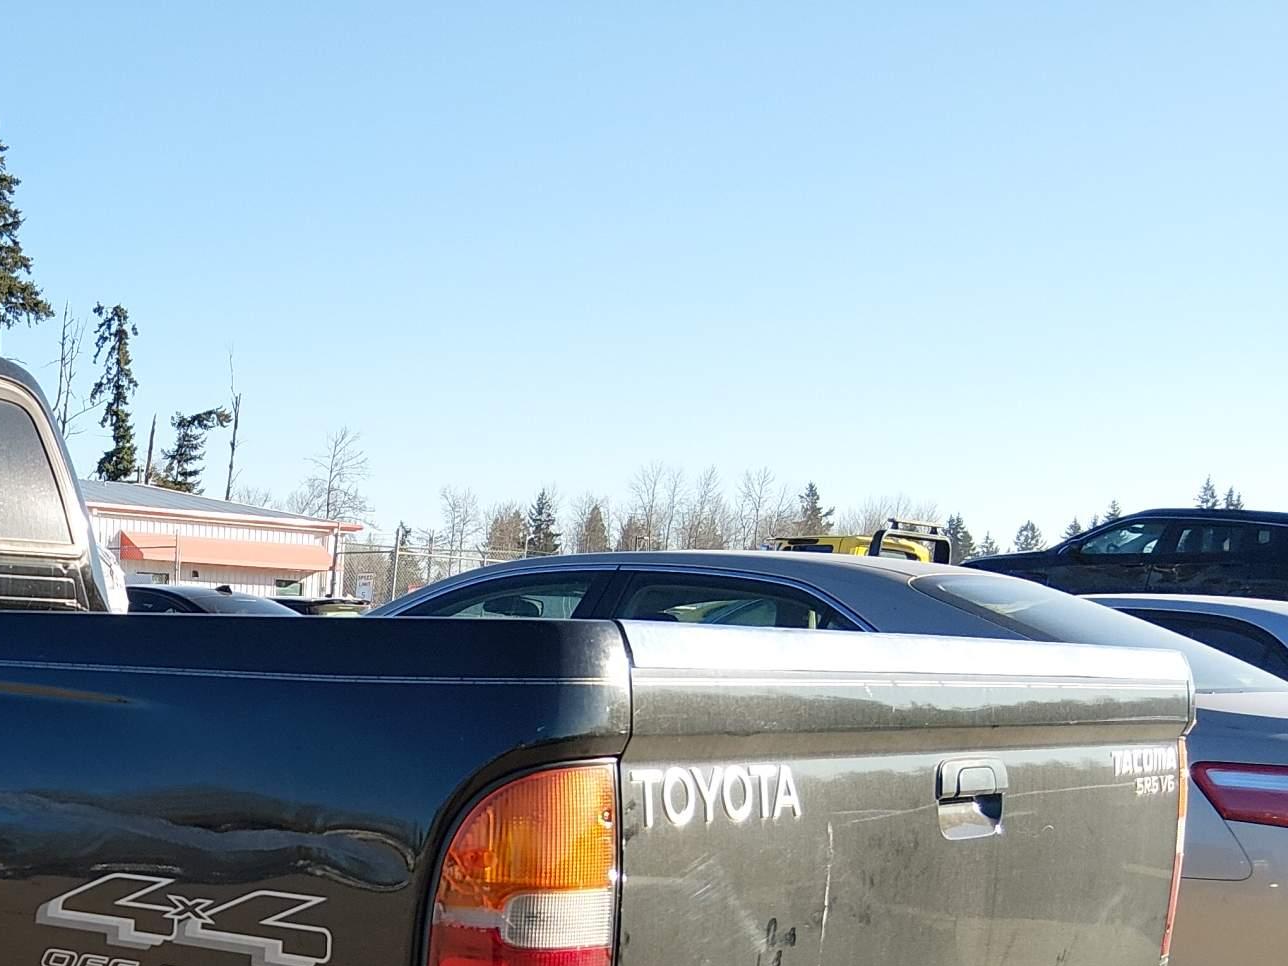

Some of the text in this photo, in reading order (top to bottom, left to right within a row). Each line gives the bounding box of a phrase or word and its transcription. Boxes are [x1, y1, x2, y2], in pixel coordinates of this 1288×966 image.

[1111, 747, 1177, 776] TACOMA
[630, 764, 802, 828] TOYOTA
[1135, 775, 1175, 795] SR5 V6
